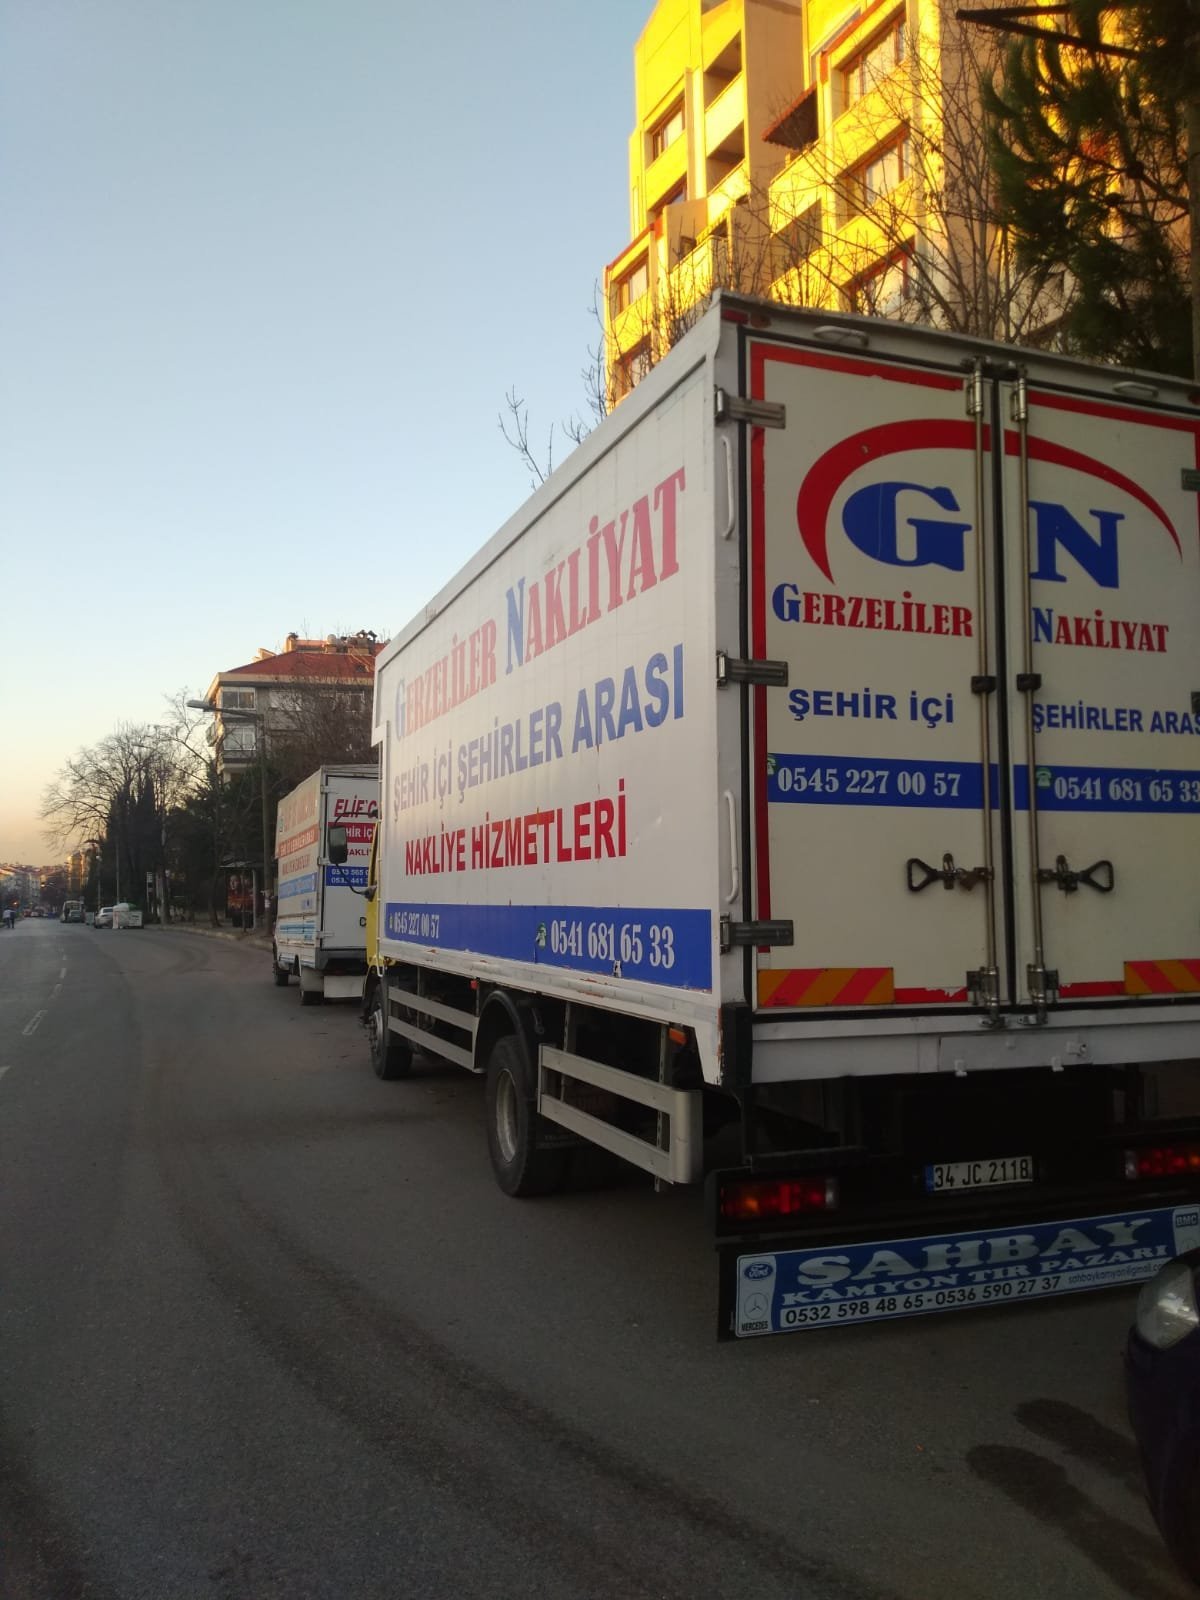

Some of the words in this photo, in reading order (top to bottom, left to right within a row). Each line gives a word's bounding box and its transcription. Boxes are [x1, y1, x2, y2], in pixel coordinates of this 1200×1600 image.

[842, 482, 972, 572] G
[1028, 501, 1125, 588] N
[506, 466, 686, 675] NAKLİYAT
[772, 583, 973, 637] GERZELİLER
[394, 756, 429, 822] ŞEHİR
[458, 701, 563, 804] ŞEHİRLER
[571, 643, 684, 754] ARASI
[788, 688, 897, 721] ŞEHİR
[910, 690, 954, 728] İÇİ
[1032, 700, 1144, 734] ŞEHİRLER
[777, 766, 838, 792] 0545
[846, 768, 891, 794] 227
[897, 771, 926, 795] 00
[934, 773, 961, 797] 57
[1054, 776, 1103, 801] 0541
[1108, 778, 1144, 802] 681
[1149, 779, 1174, 803] 65
[1179, 780, 1200, 803] 33
[405, 821, 466, 876] NAKLİYE
[471, 778, 627, 870] HİZMETLERİ
[430, 914, 440, 940] 57
[551, 919, 583, 957] 0541
[588, 922, 615, 961] 681
[620, 924, 643, 964] 65
[650, 925, 675, 969] 33
[935, 1166, 955, 1188] 34
[962, 1164, 982, 1186] JC
[989, 1159, 1029, 1183] 2118
[782, 1273, 960, 1306] KAMYON
[968, 1264, 1031, 1282] TIR
[1040, 1245, 1168, 1273] PAZARI
[785, 1305, 831, 1324] 0532
[837, 1301, 870, 1318] 598
[876, 1297, 897, 1313] 48
[982, 1282, 1012, 1299] 590
[1017, 1279, 1037, 1294] 27
[1042, 1276, 1061, 1290] 37
